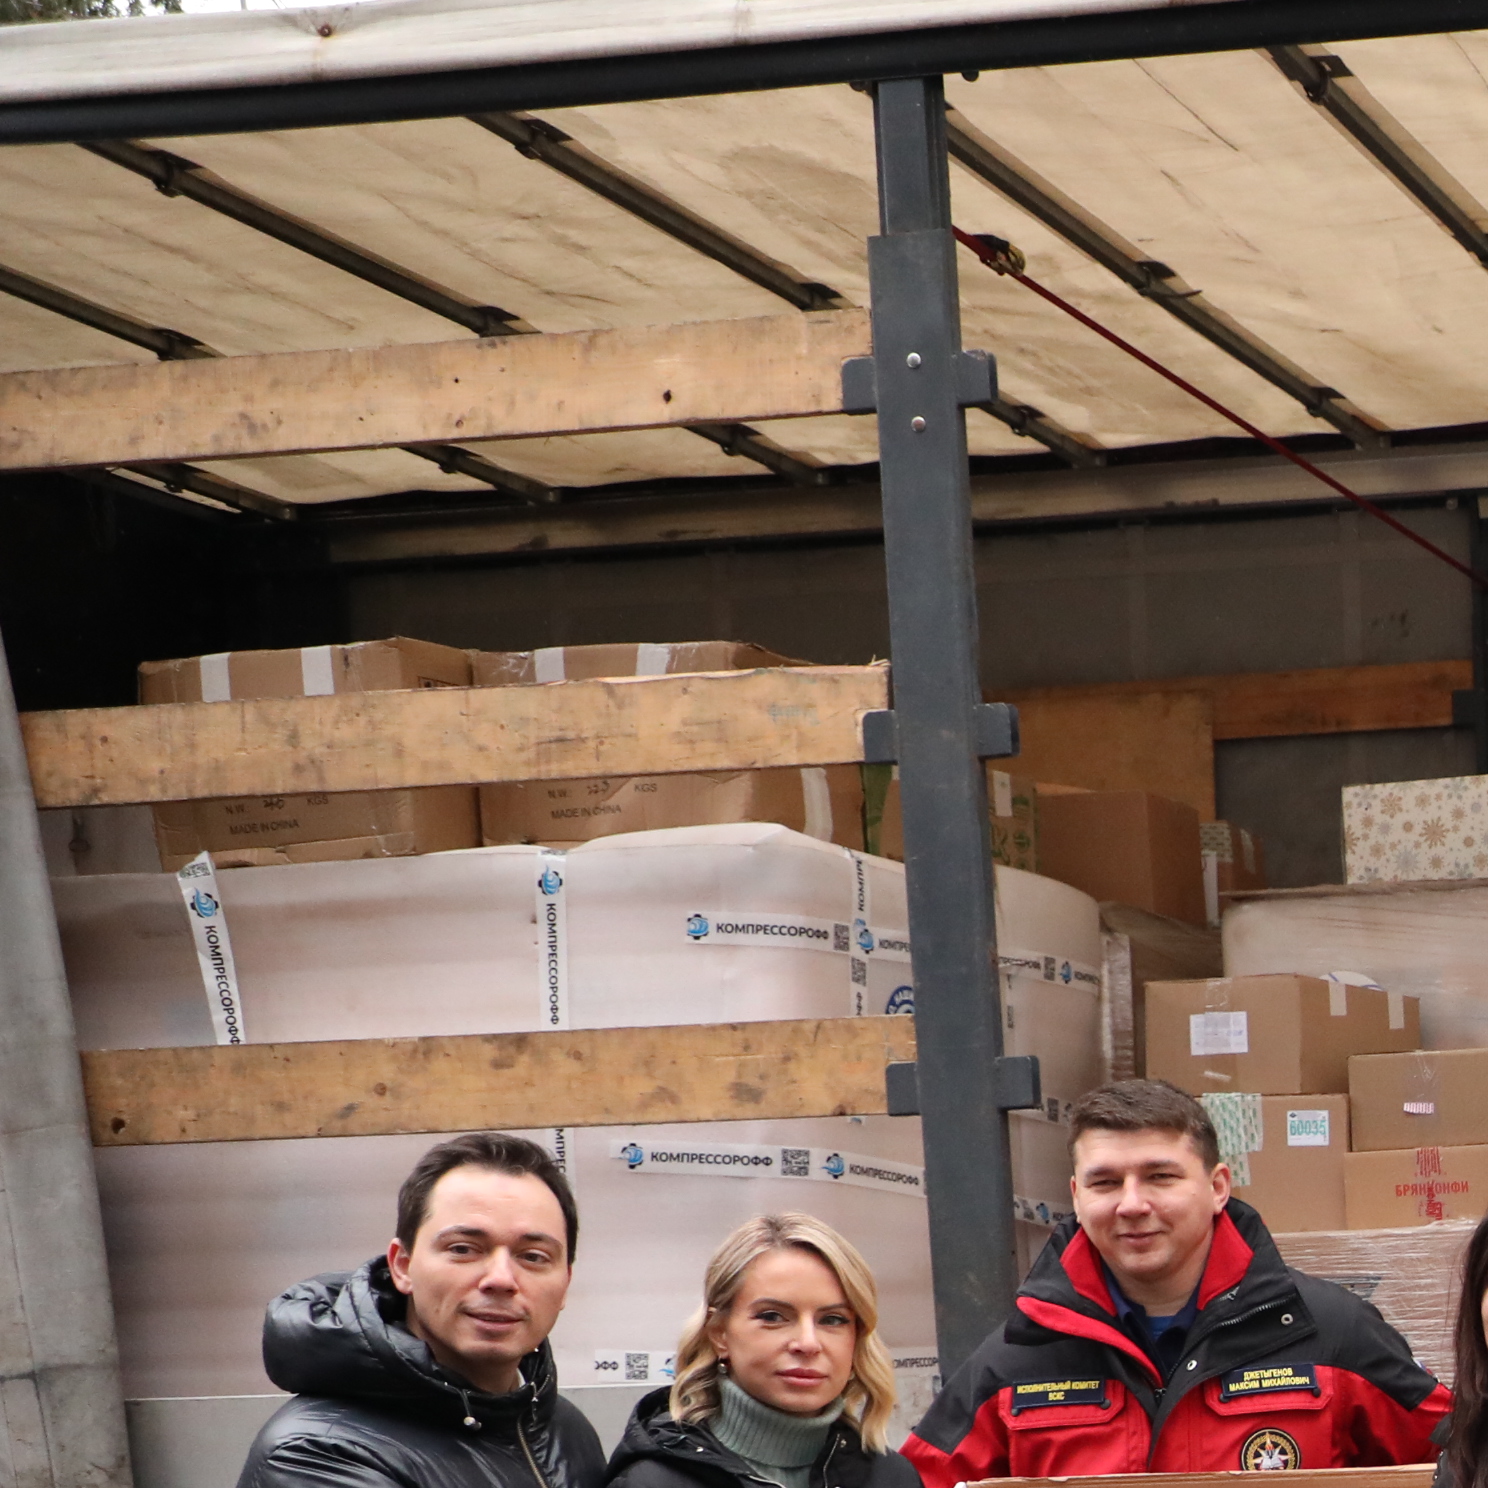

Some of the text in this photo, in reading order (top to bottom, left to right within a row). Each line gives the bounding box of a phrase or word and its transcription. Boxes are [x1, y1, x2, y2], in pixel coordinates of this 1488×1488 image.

[634, 783, 658, 793] KGS
[551, 805, 622, 819] MADE IN CHINA
[229, 818, 299, 835] MADE IN CHINA
[716, 922, 829, 941] КОМПРЕССОРОФФ
[546, 903, 560, 1025] КОМПРЕССОРОФФ
[650, 1150, 773, 1168] КОМПРЕССОРОФФ
[849, 1163, 920, 1187] КОМПРЕССОРОФФ
[1395, 1181, 1470, 1198] БРЯНКОНФИ
[1243, 1367, 1294, 1382] ДЖЕТЫГЕНОВ
[1016, 1380, 1100, 1395] ИСПОЛНИТЕЛЬНЫЙ КОМИТЕТ
[1229, 1376, 1310, 1392] МАКСИМ МИХАЙЛОВИЧ
